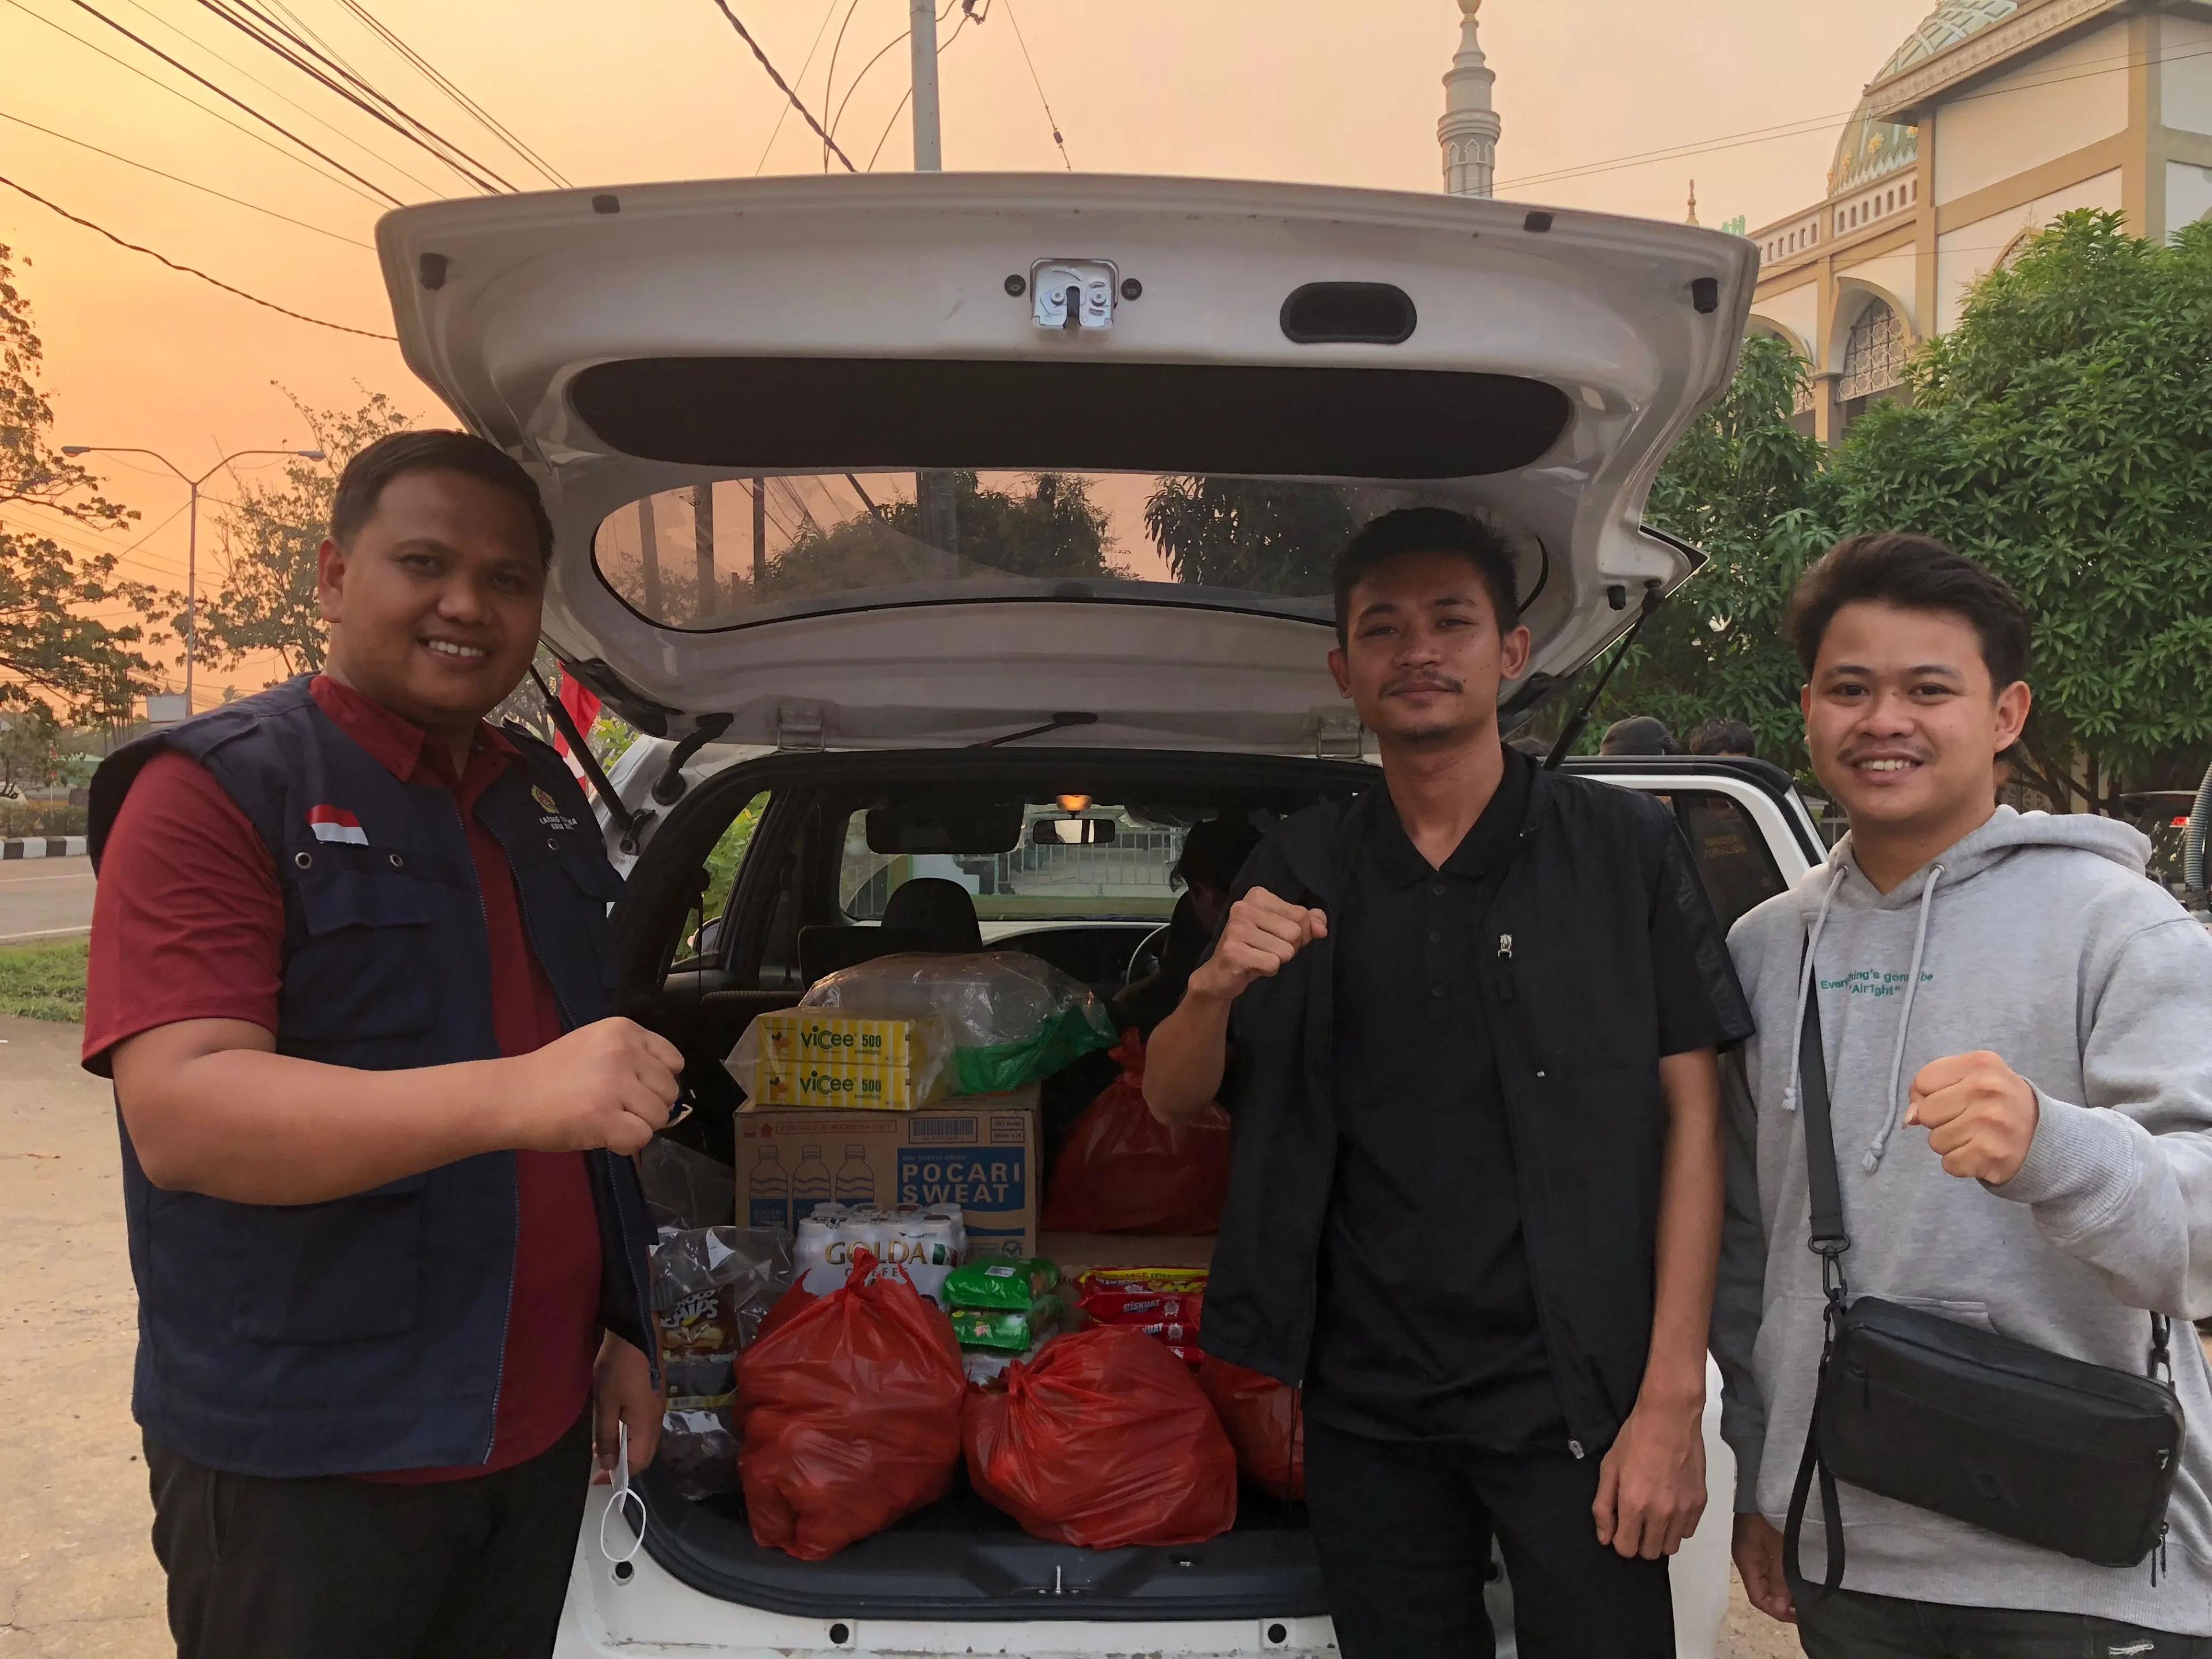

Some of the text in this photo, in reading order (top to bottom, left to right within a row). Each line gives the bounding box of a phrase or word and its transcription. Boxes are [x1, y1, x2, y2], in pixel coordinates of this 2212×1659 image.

[1921, 972, 1933, 982] be
[862, 1034, 881, 1048] 500
[862, 1079, 881, 1092] 500
[902, 1162, 1020, 1183] POCARI
[902, 1183, 1010, 1203] SWEAT
[824, 1240, 927, 1265] GOLDA
